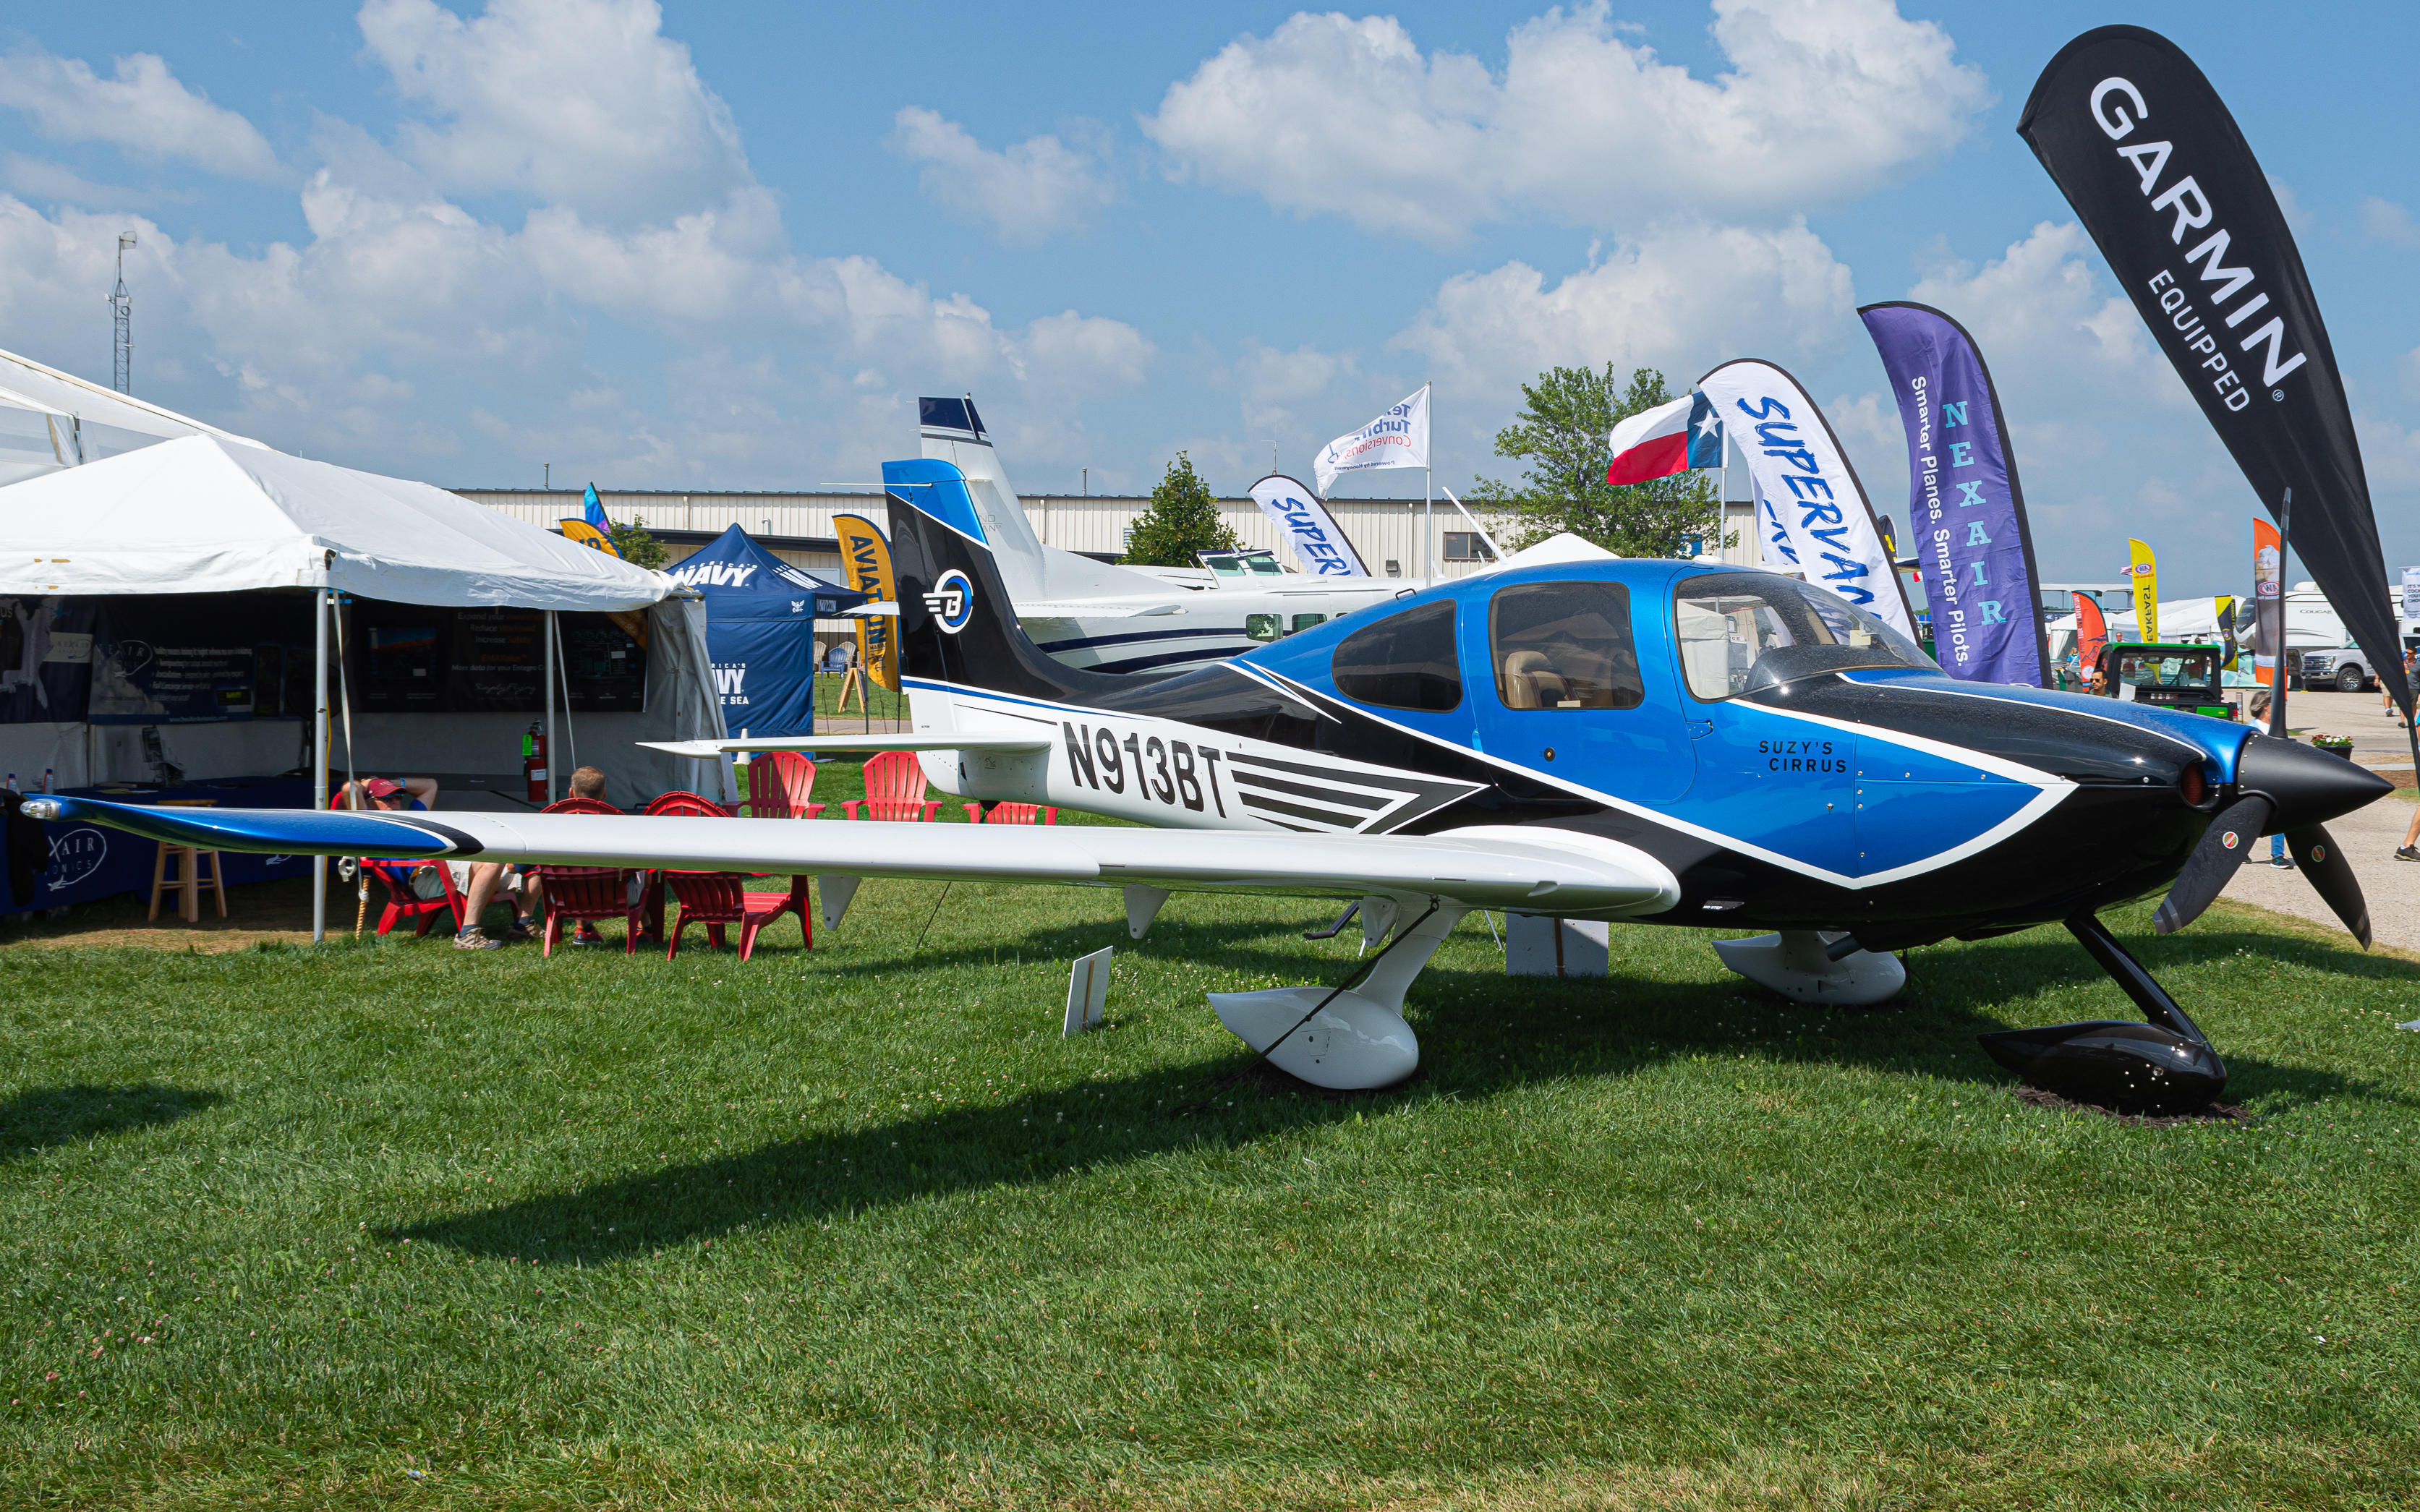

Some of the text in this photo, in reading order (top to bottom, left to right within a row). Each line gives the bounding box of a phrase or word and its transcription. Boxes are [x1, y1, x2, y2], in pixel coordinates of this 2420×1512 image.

[2089, 77, 2306, 387] GARMIN
[2148, 269, 2250, 411] EQUIPPED
[1912, 375, 1969, 667] Smarter Planes. Smarter Pilots.
[1941, 400, 2007, 626] NEXAIR
[457, 612, 487, 622] Expand
[487, 612, 505, 623] your
[470, 623, 498, 632] Reduce
[475, 636, 532, 645] Increase Safety
[512, 665, 537, 673] Entegra
[712, 668, 746, 694] VY
[730, 696, 749, 705] SEA
[1758, 740, 1833, 755] SUZY'S
[1062, 721, 1227, 820] N913BT
[1769, 757, 1846, 774] CIRRUS
[48, 835, 95, 863] XAIR
[45, 859, 93, 876] ONICS
